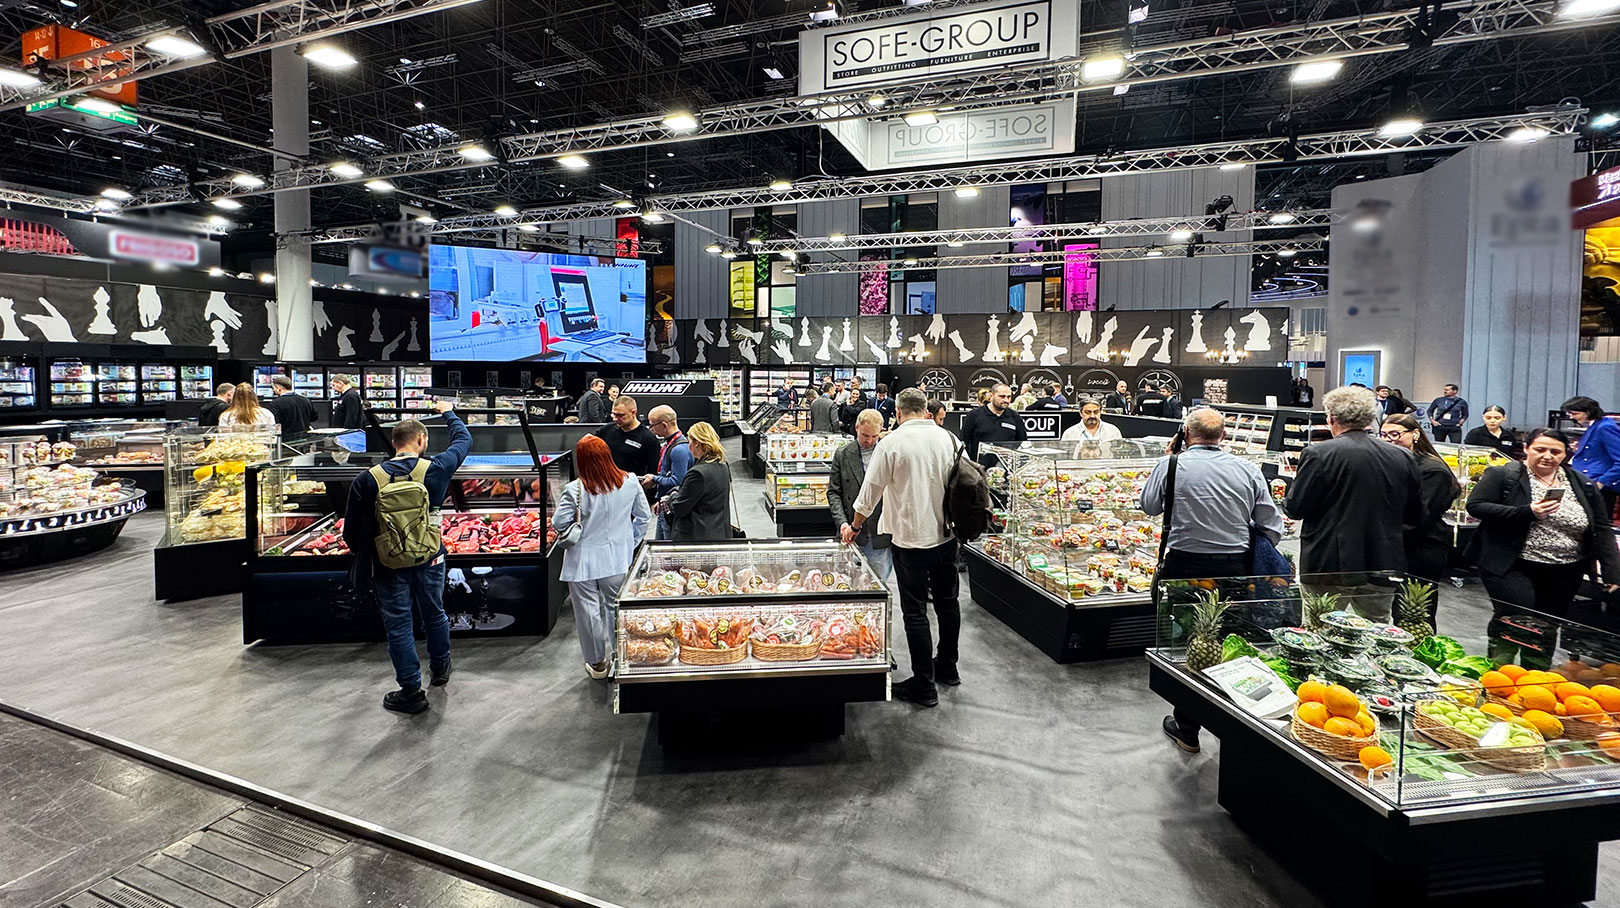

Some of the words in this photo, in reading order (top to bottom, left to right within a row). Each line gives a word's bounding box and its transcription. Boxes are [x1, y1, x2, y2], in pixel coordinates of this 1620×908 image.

[833, 11, 1040, 67] SOFE-GROUP
[836, 69, 859, 78] STORE
[871, 62, 917, 73] OUTFITTING
[930, 54, 973, 65] FURNITURE
[987, 45, 1036, 57] ENTERPRISE
